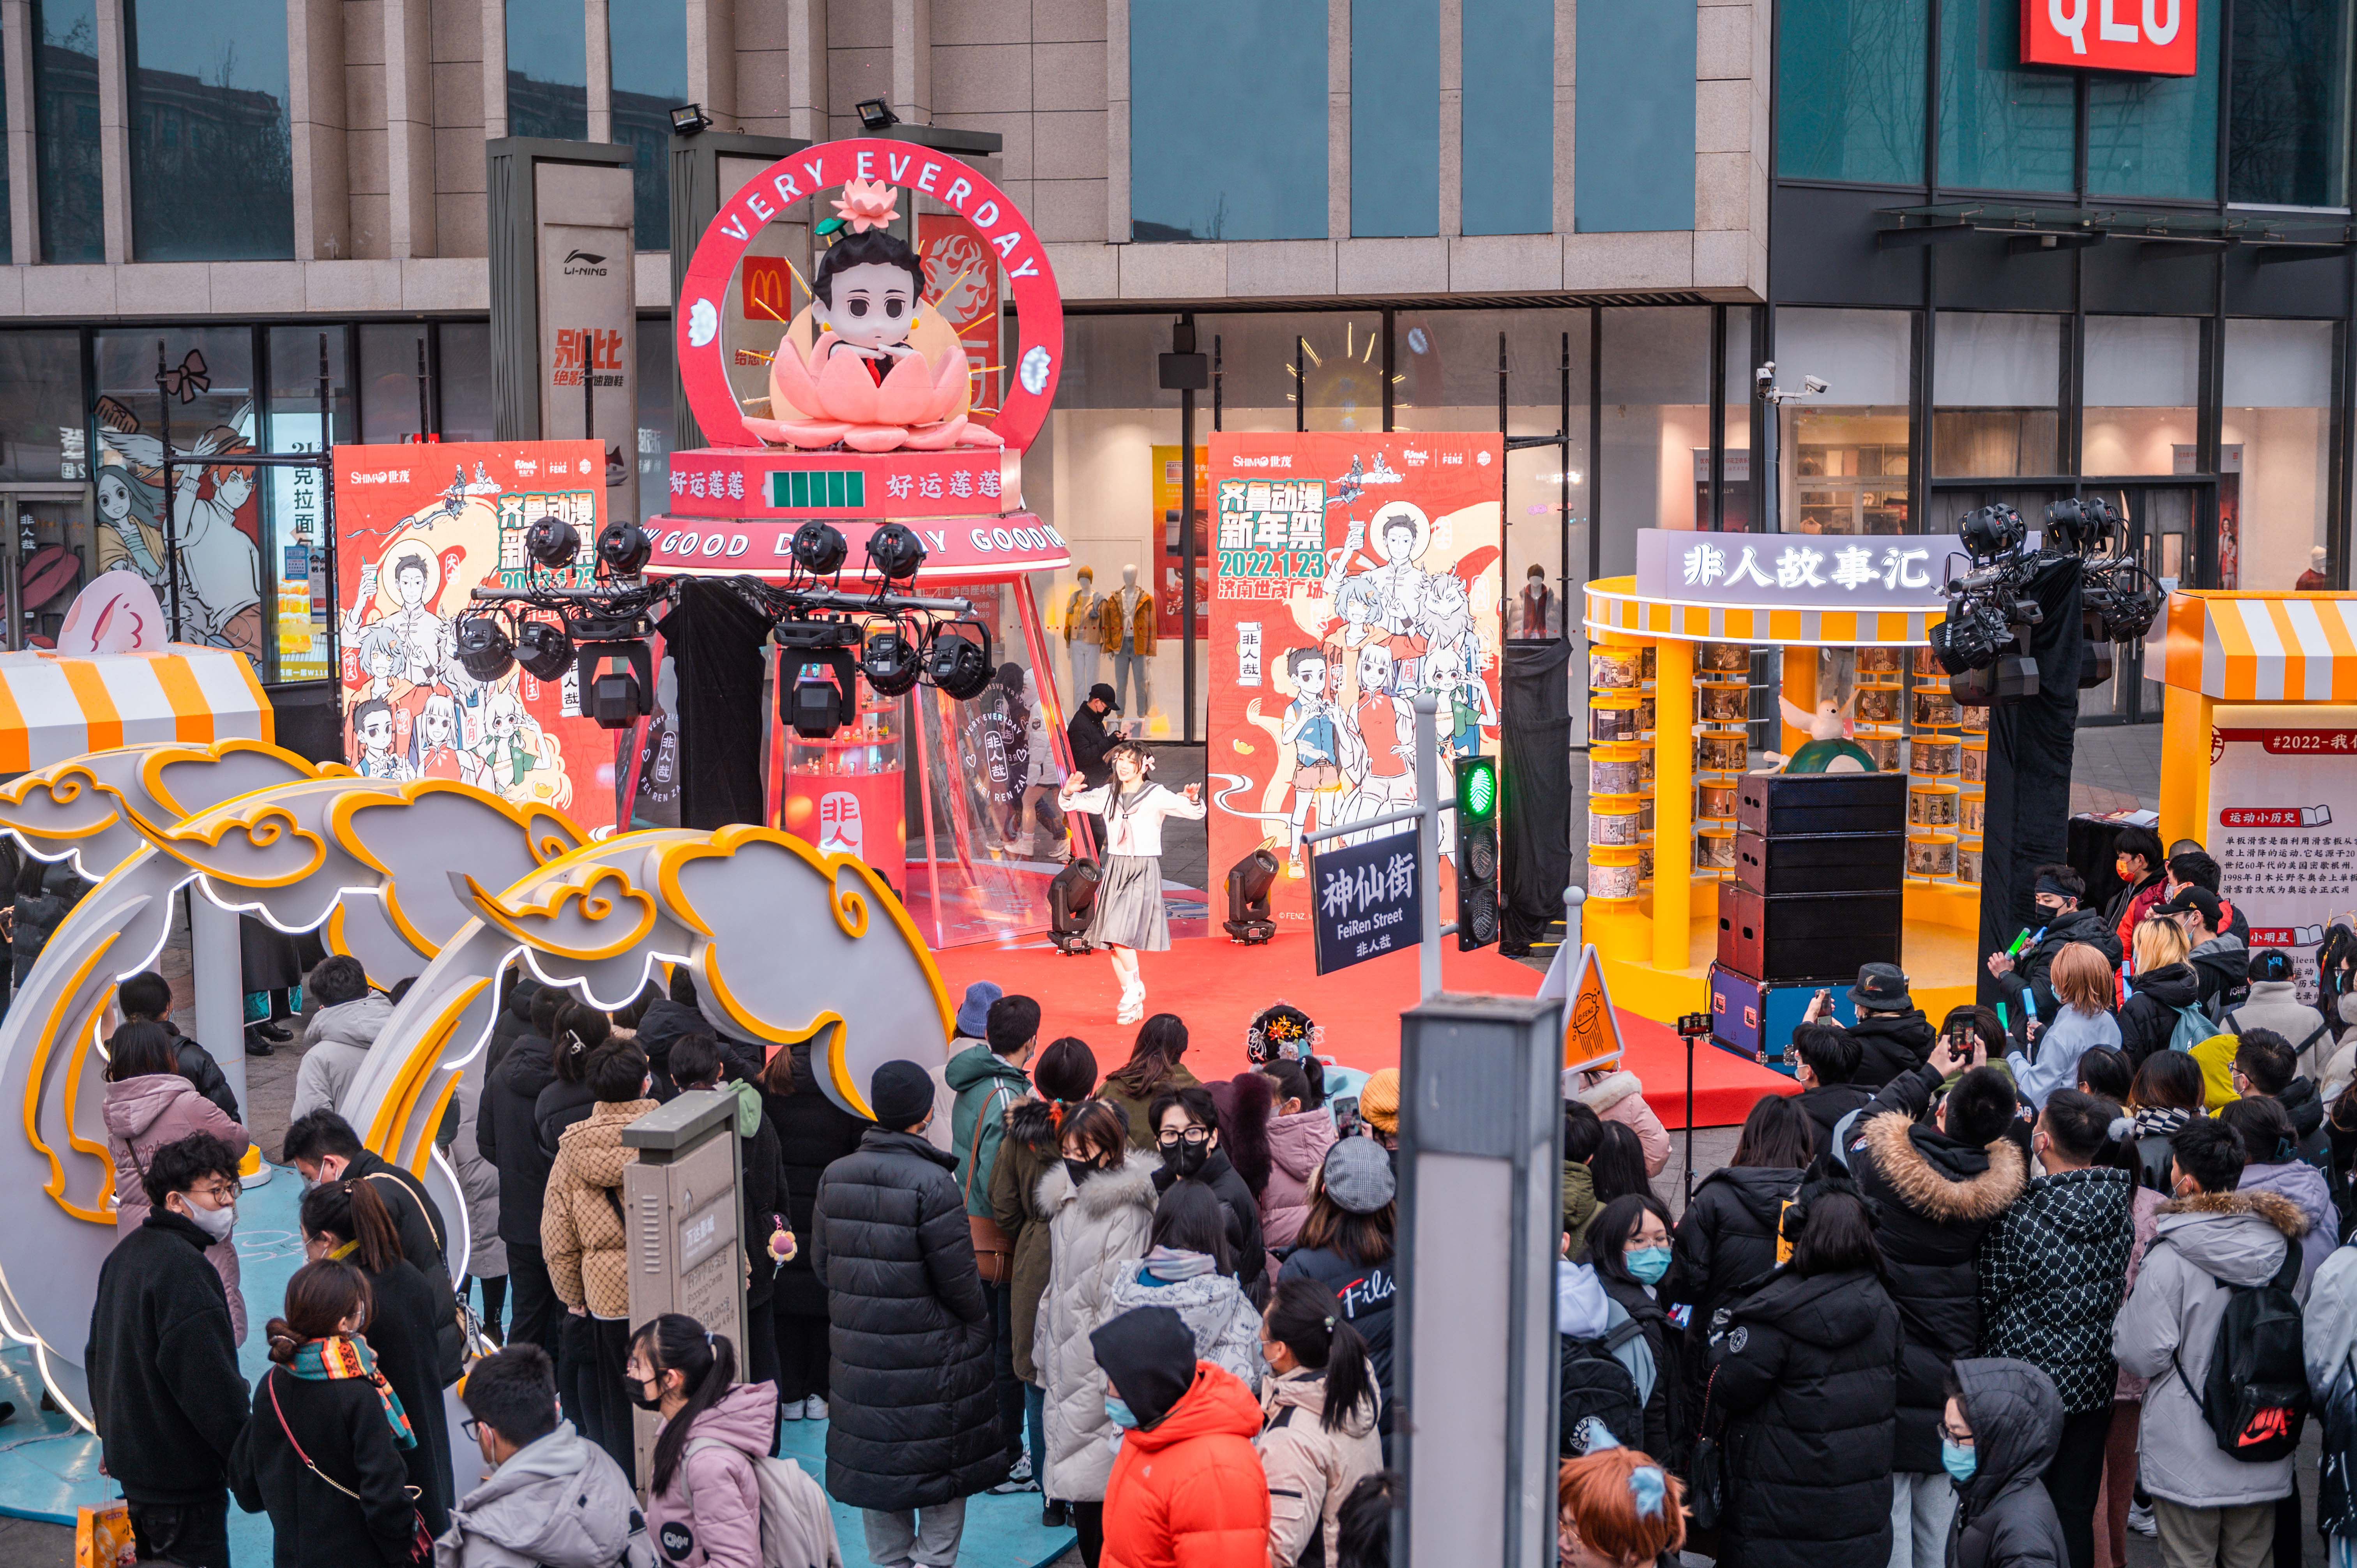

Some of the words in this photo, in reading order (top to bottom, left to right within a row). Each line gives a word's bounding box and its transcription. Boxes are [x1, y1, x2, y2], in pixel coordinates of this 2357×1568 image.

[721, 158, 824, 242] VERY
[857, 151, 1040, 279] EVERDAY
[564, 267, 607, 276] LI-NING
[553, 328, 623, 369] 别比
[553, 370, 624, 387] 绝影速跑鞋
[549, 465, 567, 473] FENZ
[1270, 455, 1292, 468] 世茂
[388, 470, 410, 483] 世茂
[670, 471, 745, 500] 好运莲莲
[886, 469, 1002, 500] 好运莲莲
[1219, 481, 1324, 512] 齐鲁动漫
[20, 514, 36, 549] 非人哉
[660, 530, 750, 558] GOOD
[970, 527, 1047, 553] GOOD
[1219, 511, 1323, 550] 新年祭
[1217, 551, 1324, 578] 2022.1.23
[1683, 543, 1930, 591] 非人故事汇
[1218, 578, 1323, 600] 济南世茂广场
[1242, 632, 1260, 676] 非人哉
[467, 717, 477, 742] 九月
[648, 714, 664, 732] VERY
[965, 717, 981, 736] VERY
[982, 713, 1022, 735] EVERYDAY
[658, 735, 674, 778] 非人哉
[986, 735, 1006, 777] 非人哉
[641, 776, 651, 795] FEI
[652, 791, 668, 802] REN
[975, 781, 990, 799] FEI
[994, 791, 1014, 802] REN
[1014, 774, 1027, 793] ZAI
[823, 796, 859, 847] 非人
[2229, 812, 2296, 823] 运动小历史
[1322, 852, 1415, 918] 神仙街
[2223, 885, 2350, 894] 滑雪首次成为奥运会正式项
[1337, 919, 1371, 940] FeiRen
[1374, 907, 1403, 930] Street
[2251, 931, 2289, 943] 小明星
[1356, 934, 1391, 957] 非人哉
[1337, 1270, 1397, 1318] Fila
